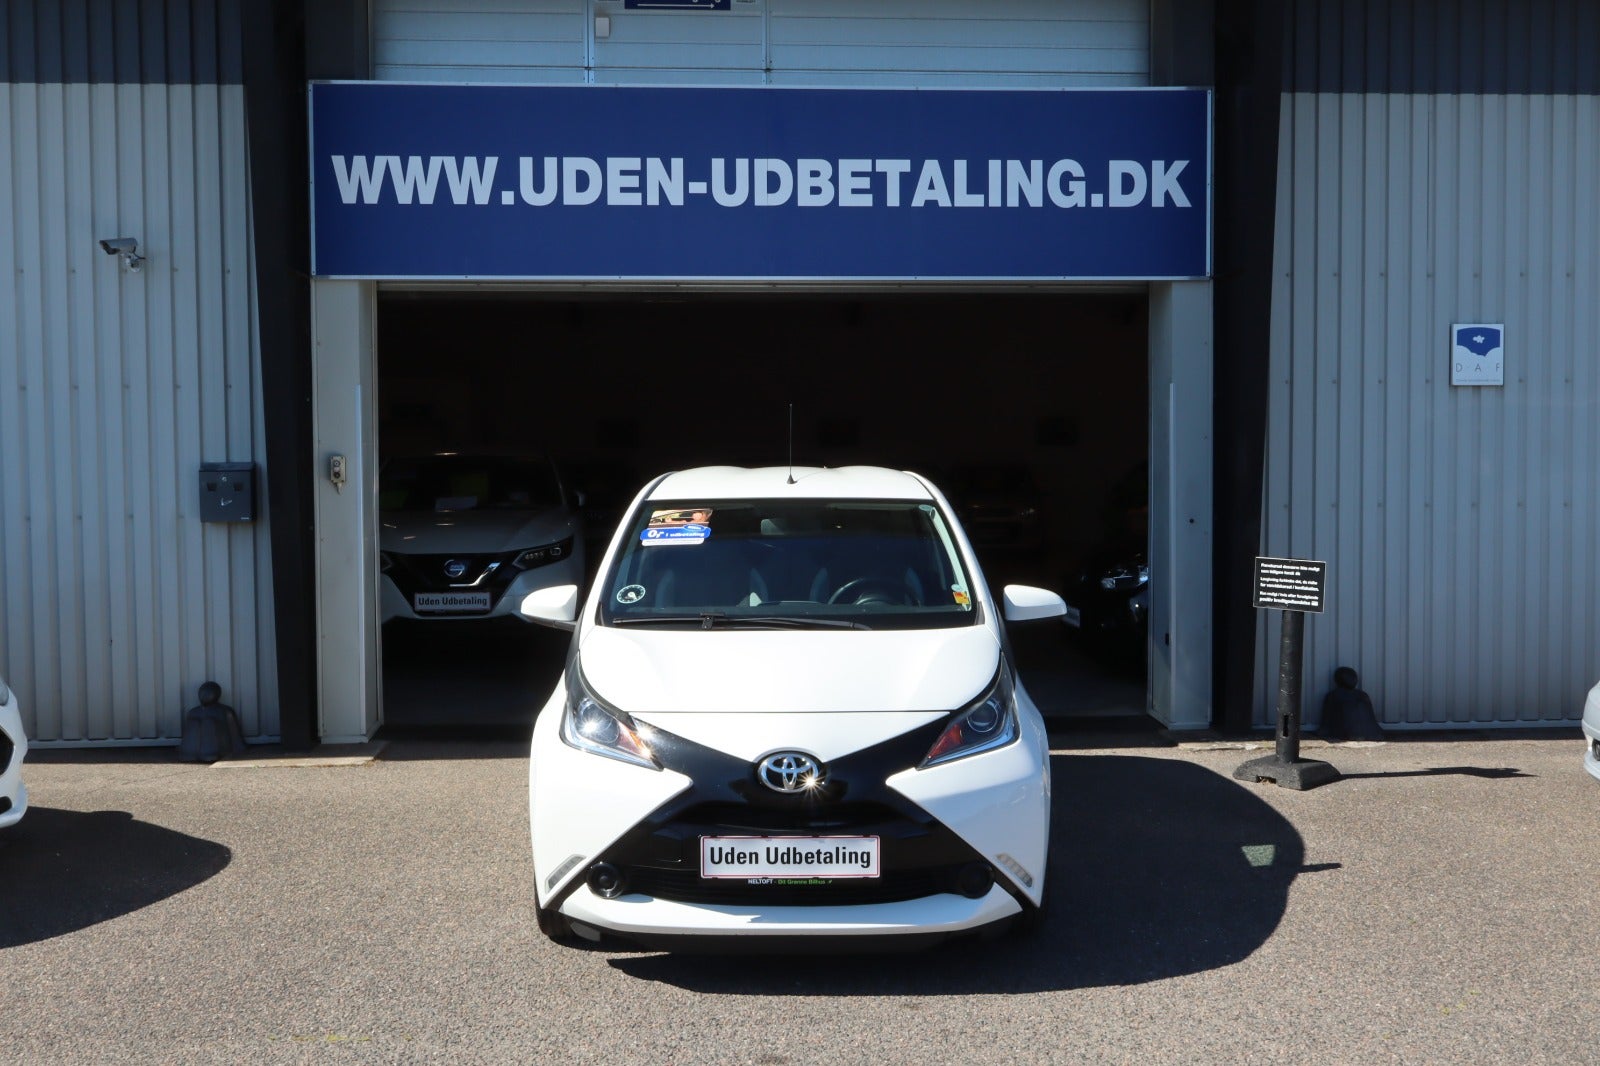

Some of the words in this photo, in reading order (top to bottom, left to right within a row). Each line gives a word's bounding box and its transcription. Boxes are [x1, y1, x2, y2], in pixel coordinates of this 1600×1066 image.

[330, 154, 1193, 209] WWW.UDEN-UDBETALING.DK
[418, 597, 440, 606] Uden
[442, 596, 487, 606] Udbetaling
[710, 846, 759, 865] Uden
[766, 846, 871, 869] Udbetaling
